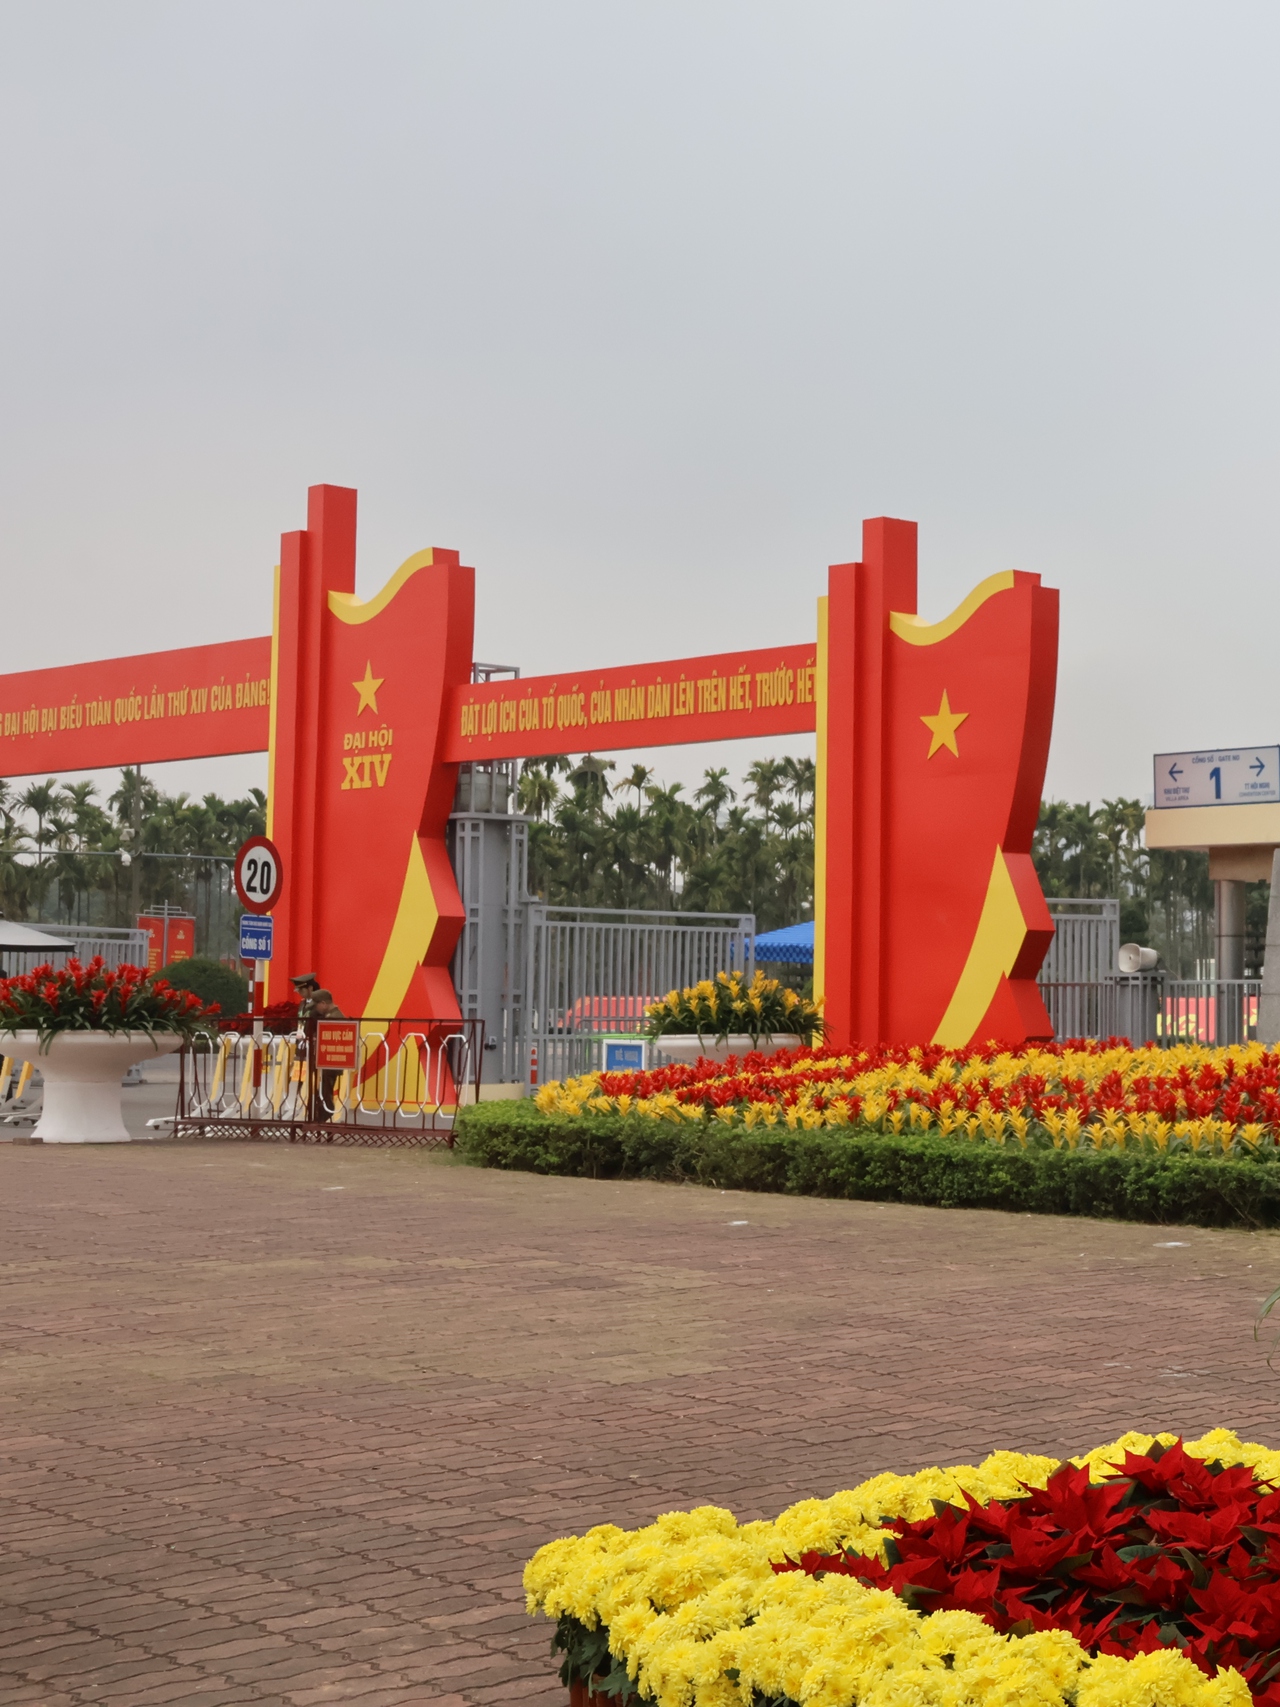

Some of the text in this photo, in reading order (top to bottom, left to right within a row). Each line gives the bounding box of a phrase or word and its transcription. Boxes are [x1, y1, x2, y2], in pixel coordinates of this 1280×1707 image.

[4, 713, 21, 741] ĐẠI
[23, 704, 40, 739] HỘI
[41, 707, 58, 737] ĐẠI
[60, 694, 83, 730] BIỂU
[85, 696, 112, 727] TOÀN
[114, 686, 143, 726] QUỐC
[144, 684, 165, 720] LẦN
[167, 684, 189, 717] THỨ
[190, 688, 208, 714] XIV
[210, 676, 232, 712] CỦA
[460, 697, 480, 743] ĐẶT
[481, 699, 498, 742] LỢI
[499, 694, 517, 733] ÍCH
[518, 688, 540, 731] CỦA
[542, 683, 557, 729] TỔ
[557, 684, 588, 731] QUỐC,
[590, 679, 612, 724] CỦA
[614, 679, 645, 722] NHÂN
[647, 676, 671, 719] DÂN
[673, 673, 695, 716] LÊN
[697, 669, 726, 713] TRÊN
[729, 664, 752, 713] HẾT,
[755, 661, 794, 708] TRƯỚC
[343, 723, 393, 754] ĐẠI HỘI
[341, 753, 392, 790] XIV
[1209, 767, 1221, 799] 1
[246, 858, 271, 895] 20
[267, 939, 271, 951] 1
